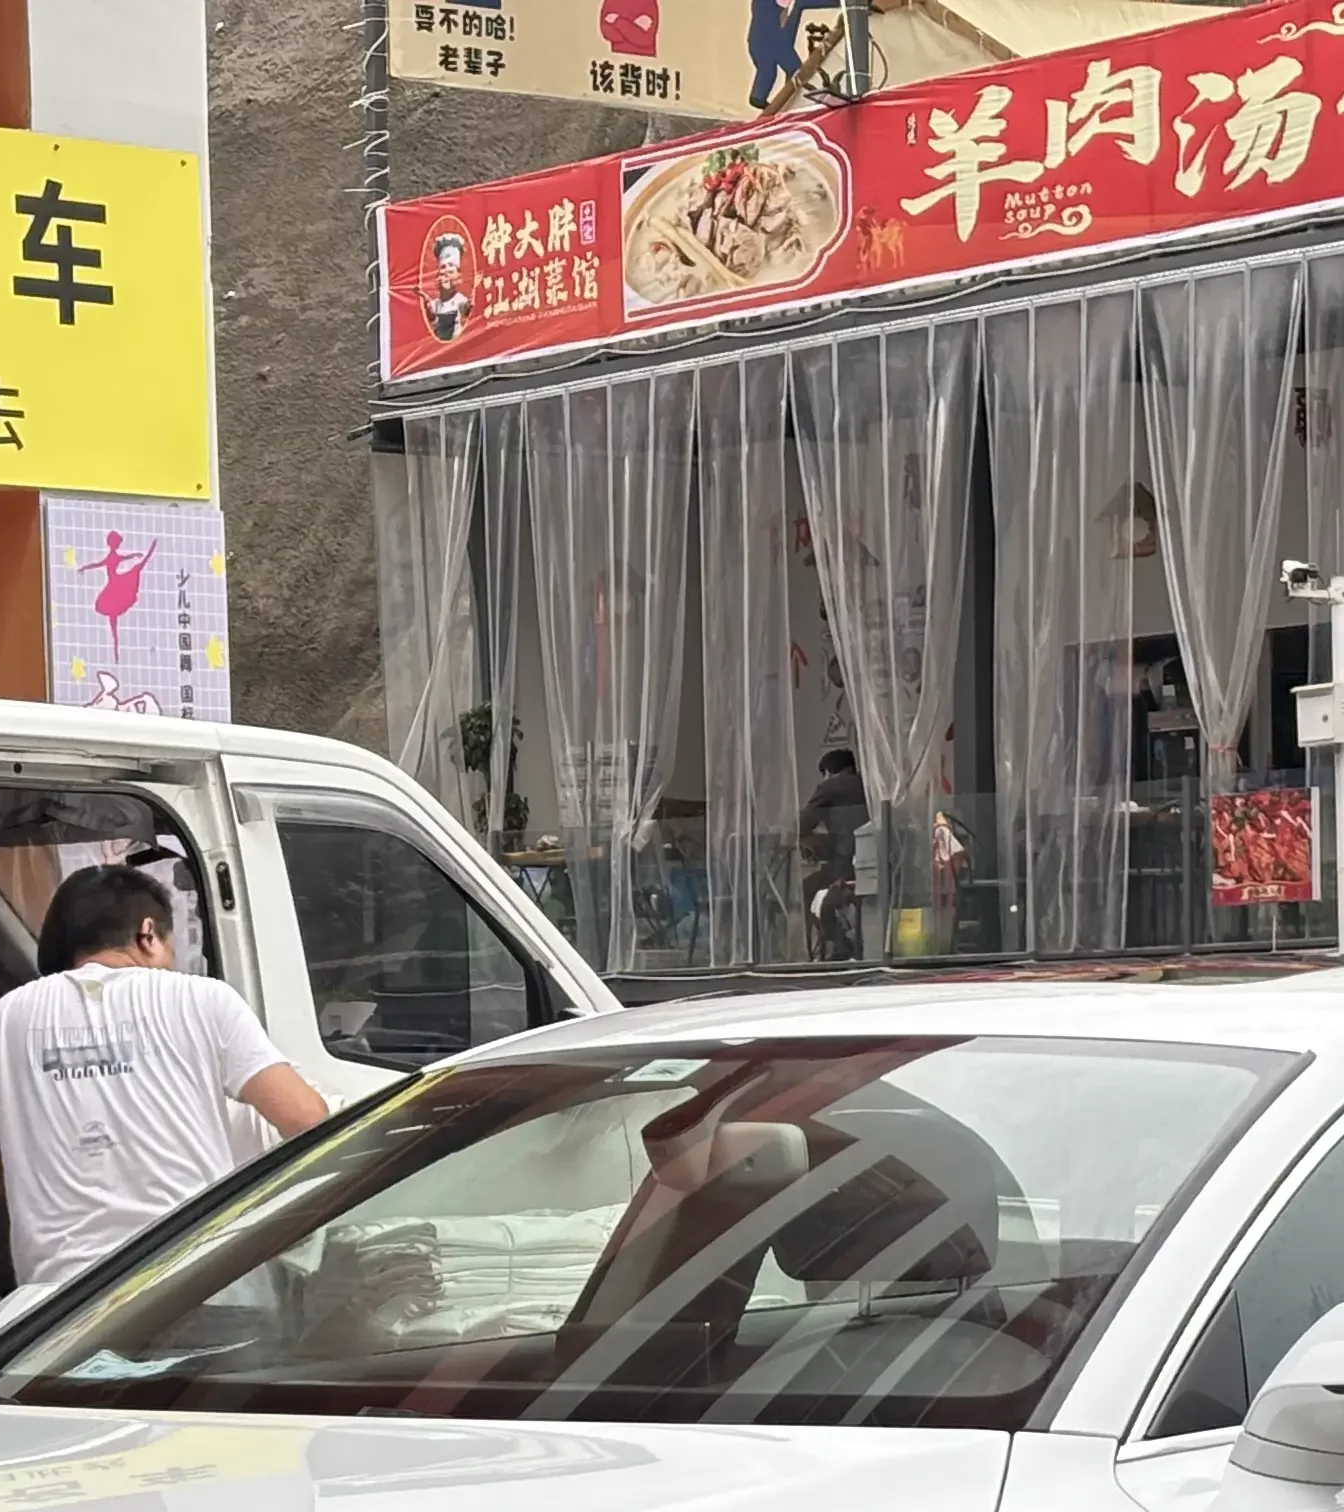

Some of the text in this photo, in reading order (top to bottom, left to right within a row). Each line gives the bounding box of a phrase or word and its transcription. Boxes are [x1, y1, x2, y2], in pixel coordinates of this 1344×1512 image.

[438, 44, 506, 77] 老辈子
[590, 60, 682, 101] 该背时!
[1004, 182, 1093, 210] Mutton
[1004, 203, 1057, 224] soup
[482, 197, 577, 267] 钟大胖
[483, 251, 600, 319] 江湖菜馆
